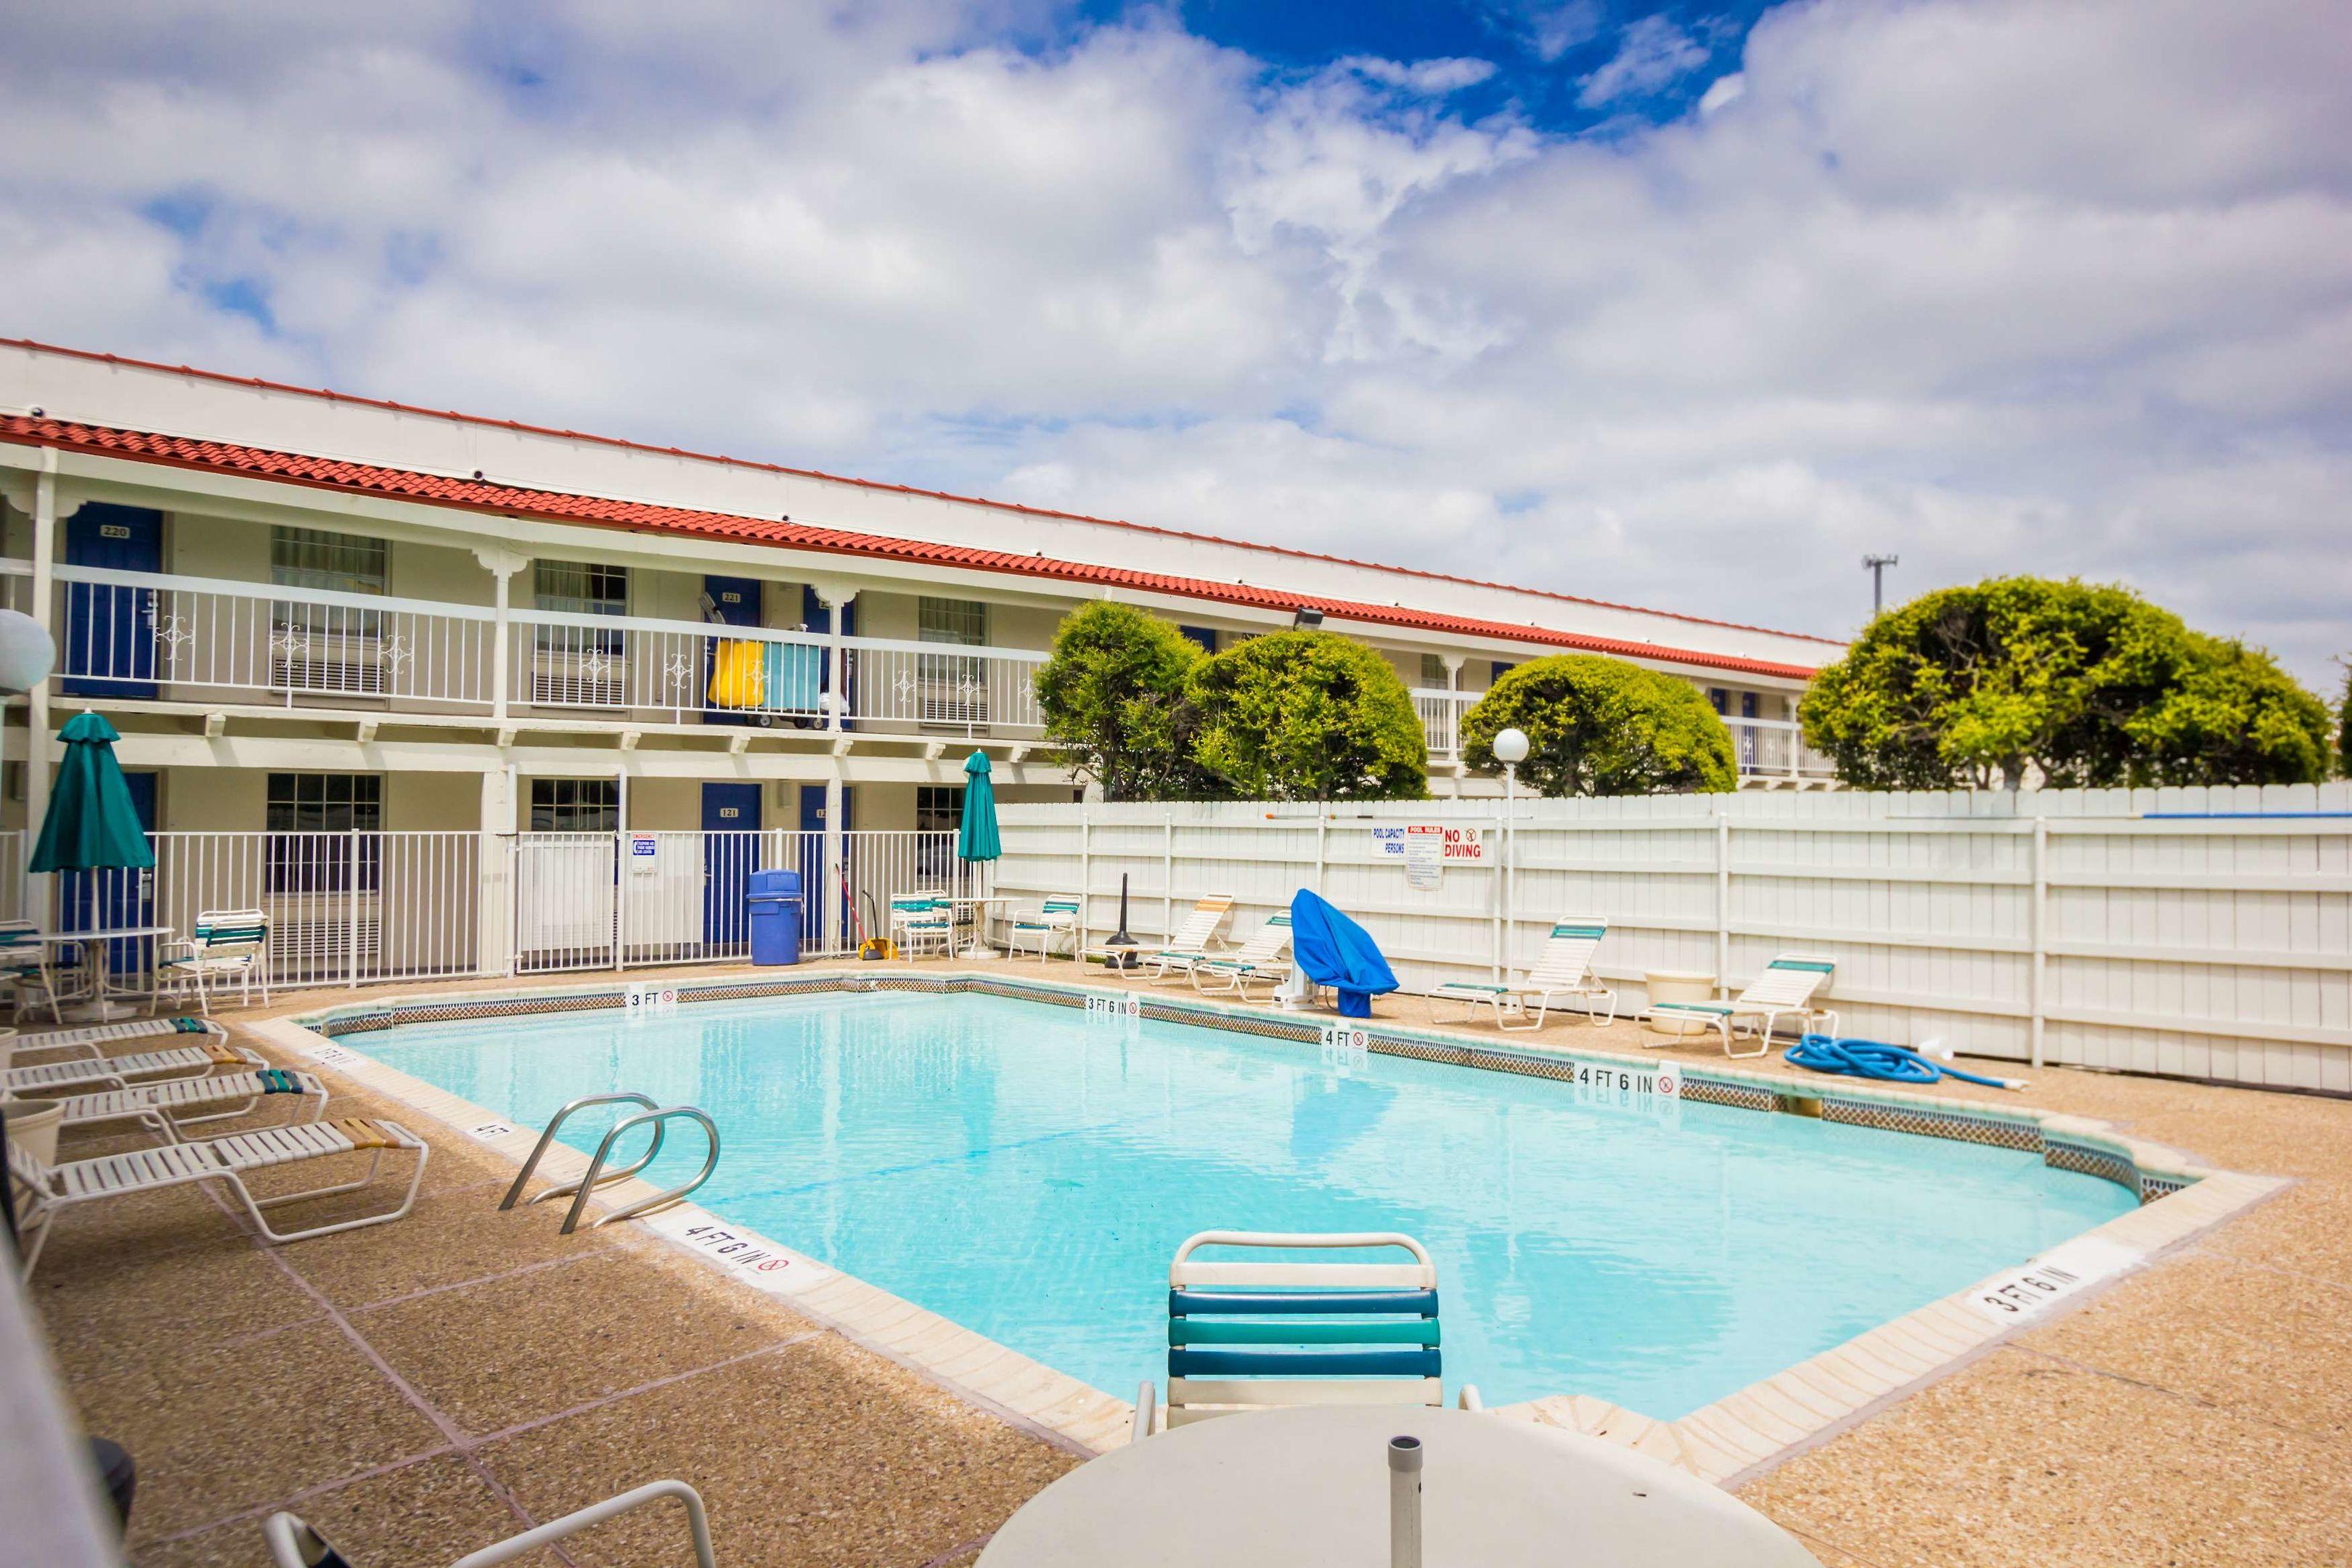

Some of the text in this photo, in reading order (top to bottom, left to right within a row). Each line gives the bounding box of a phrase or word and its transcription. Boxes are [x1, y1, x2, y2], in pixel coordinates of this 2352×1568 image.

[104, 527, 126, 537] 220
[1373, 828, 1384, 838] POOL
[1385, 828, 1405, 839] CAPACITY
[1445, 829, 1460, 843] NO
[1385, 843, 1404, 854] PERSONS
[1445, 844, 1481, 857] DIVING
[632, 992, 659, 1006] 3 FT
[1088, 997, 1127, 1016] 3 FT 6 IN
[1326, 1030, 1349, 1047] 4 FT
[1580, 1068, 1653, 1093] 4 FT 6 IN
[685, 1225, 714, 1236] 4
[695, 1231, 736, 1246] FT
[730, 1249, 771, 1265] IN
[1983, 1265, 2081, 1312] 3 FT 6 IN
